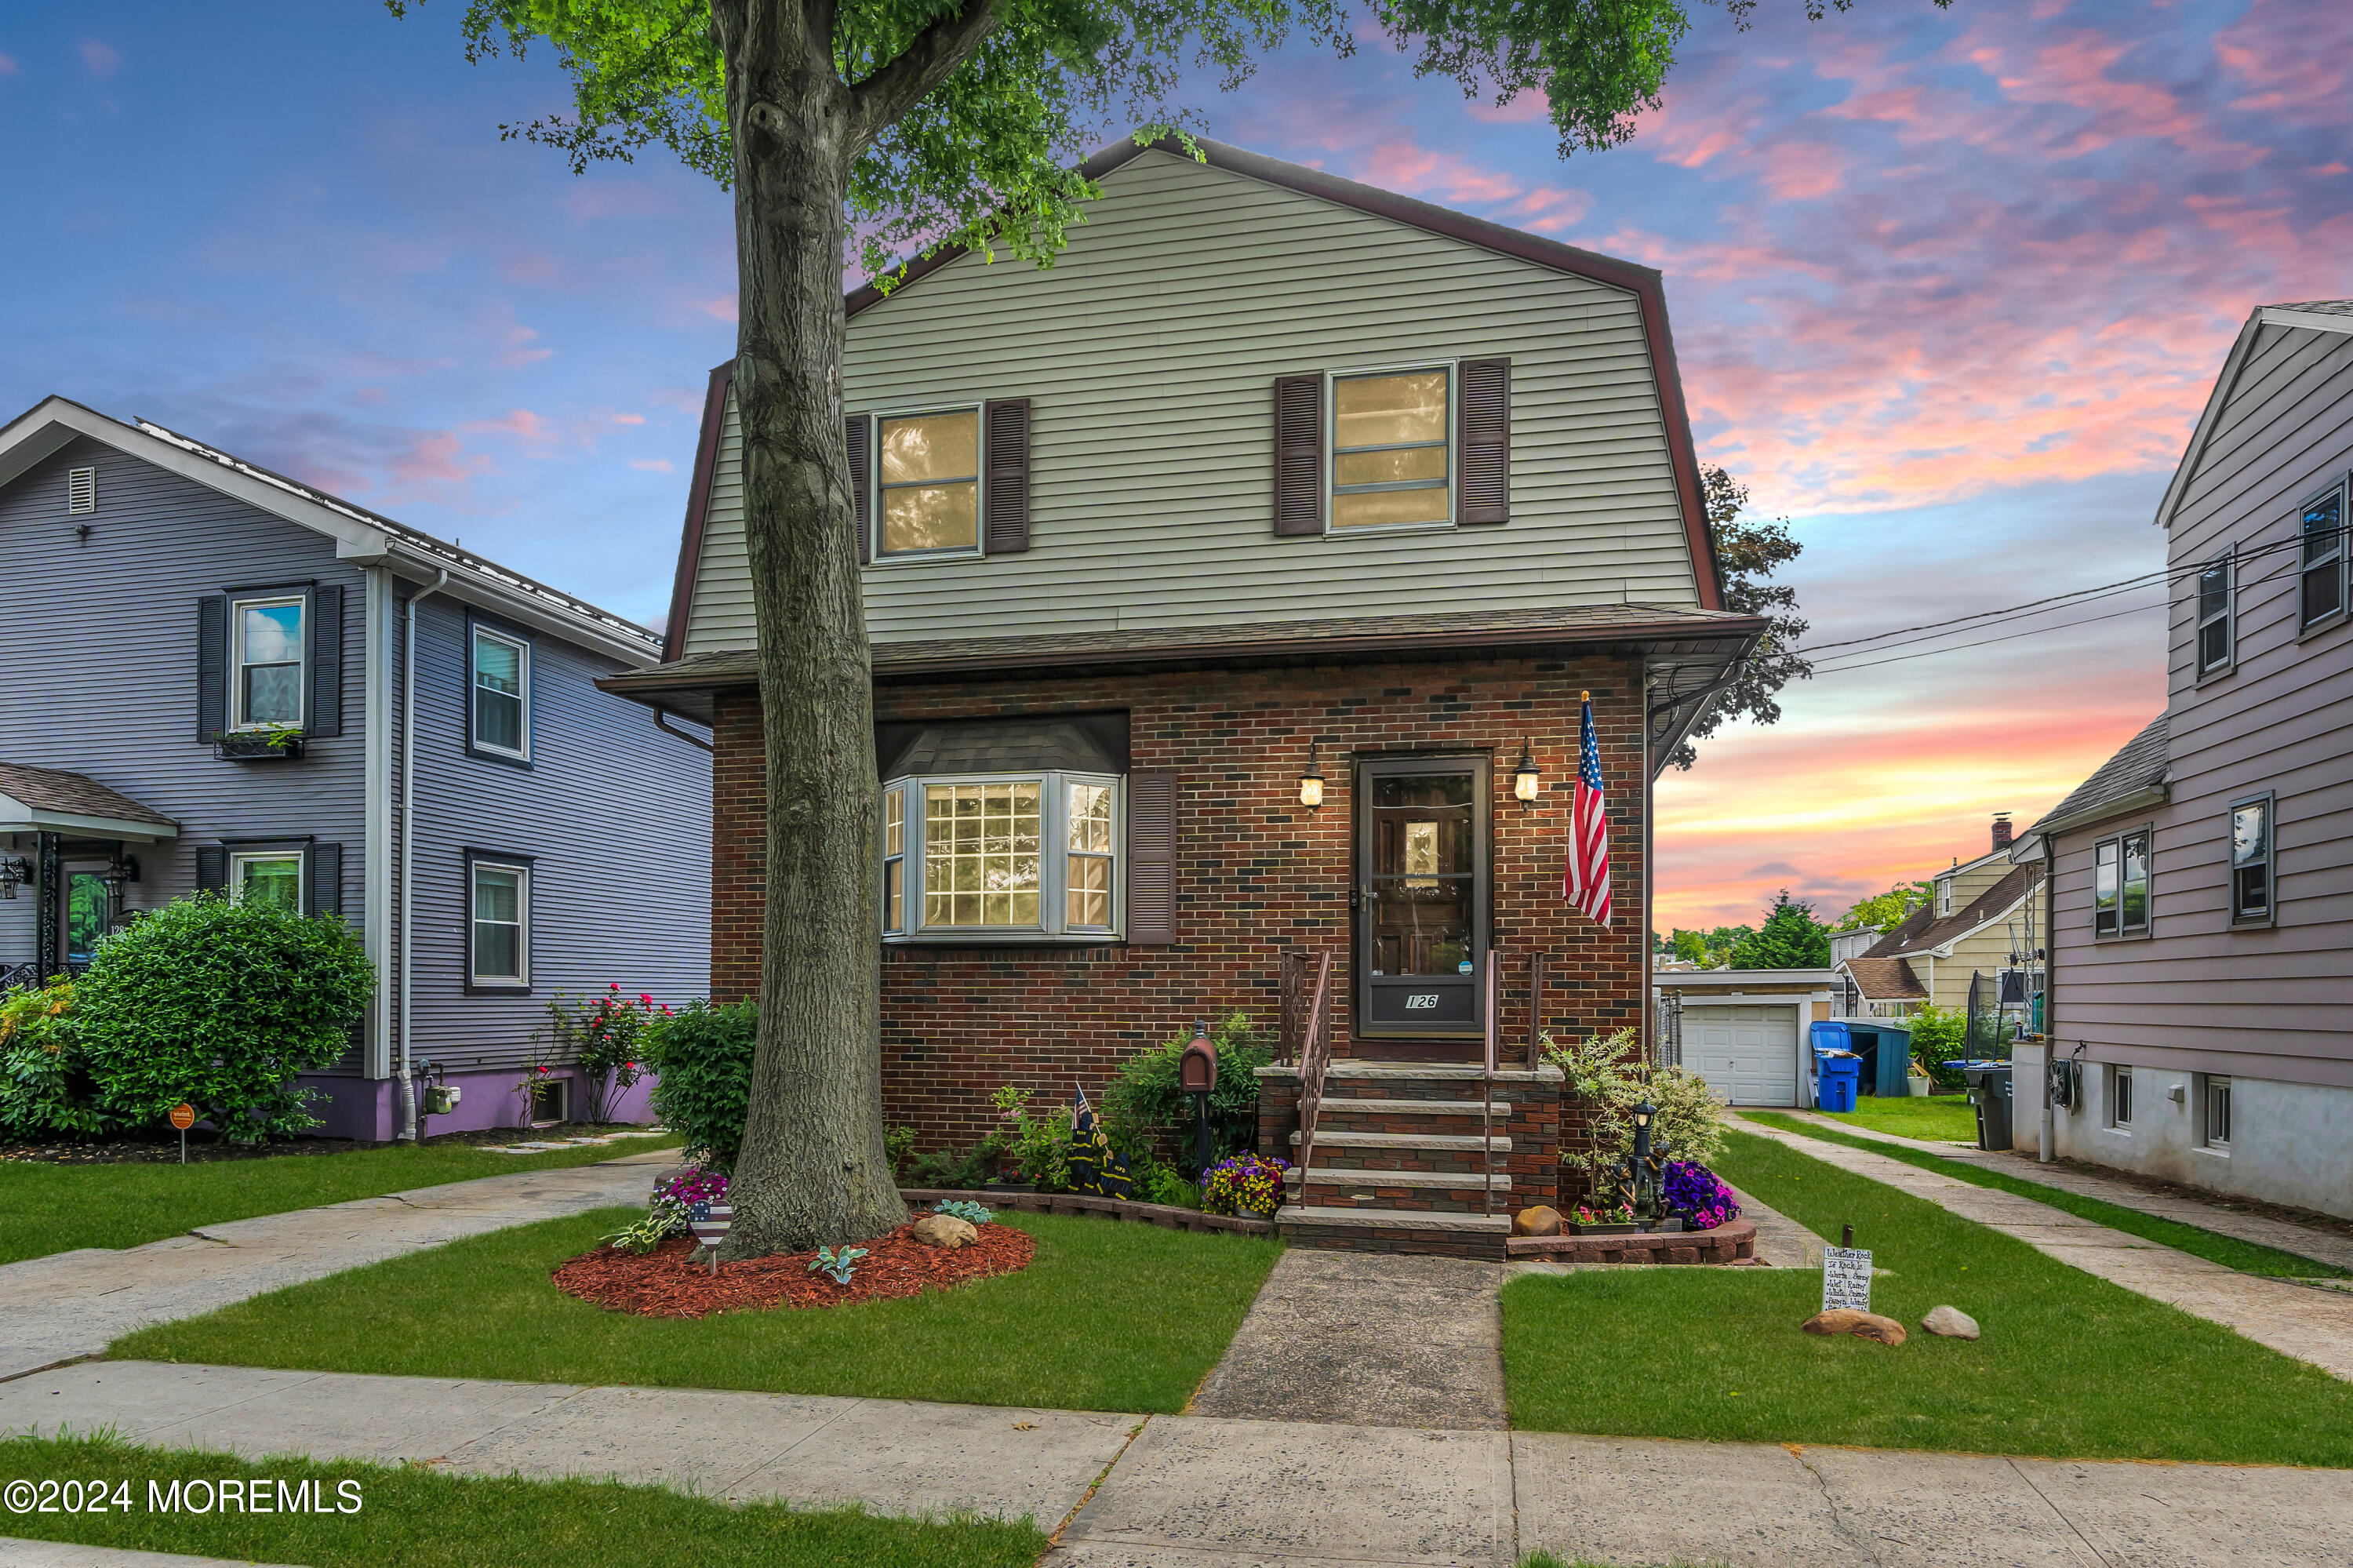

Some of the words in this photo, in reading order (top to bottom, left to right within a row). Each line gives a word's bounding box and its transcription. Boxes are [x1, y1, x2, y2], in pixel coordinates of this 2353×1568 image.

[1409, 996, 1436, 1007] 126
[1827, 1248, 1855, 1258] Weather
[1856, 1250, 1871, 1260] Rock
[1838, 1261, 1855, 1270] Rock
